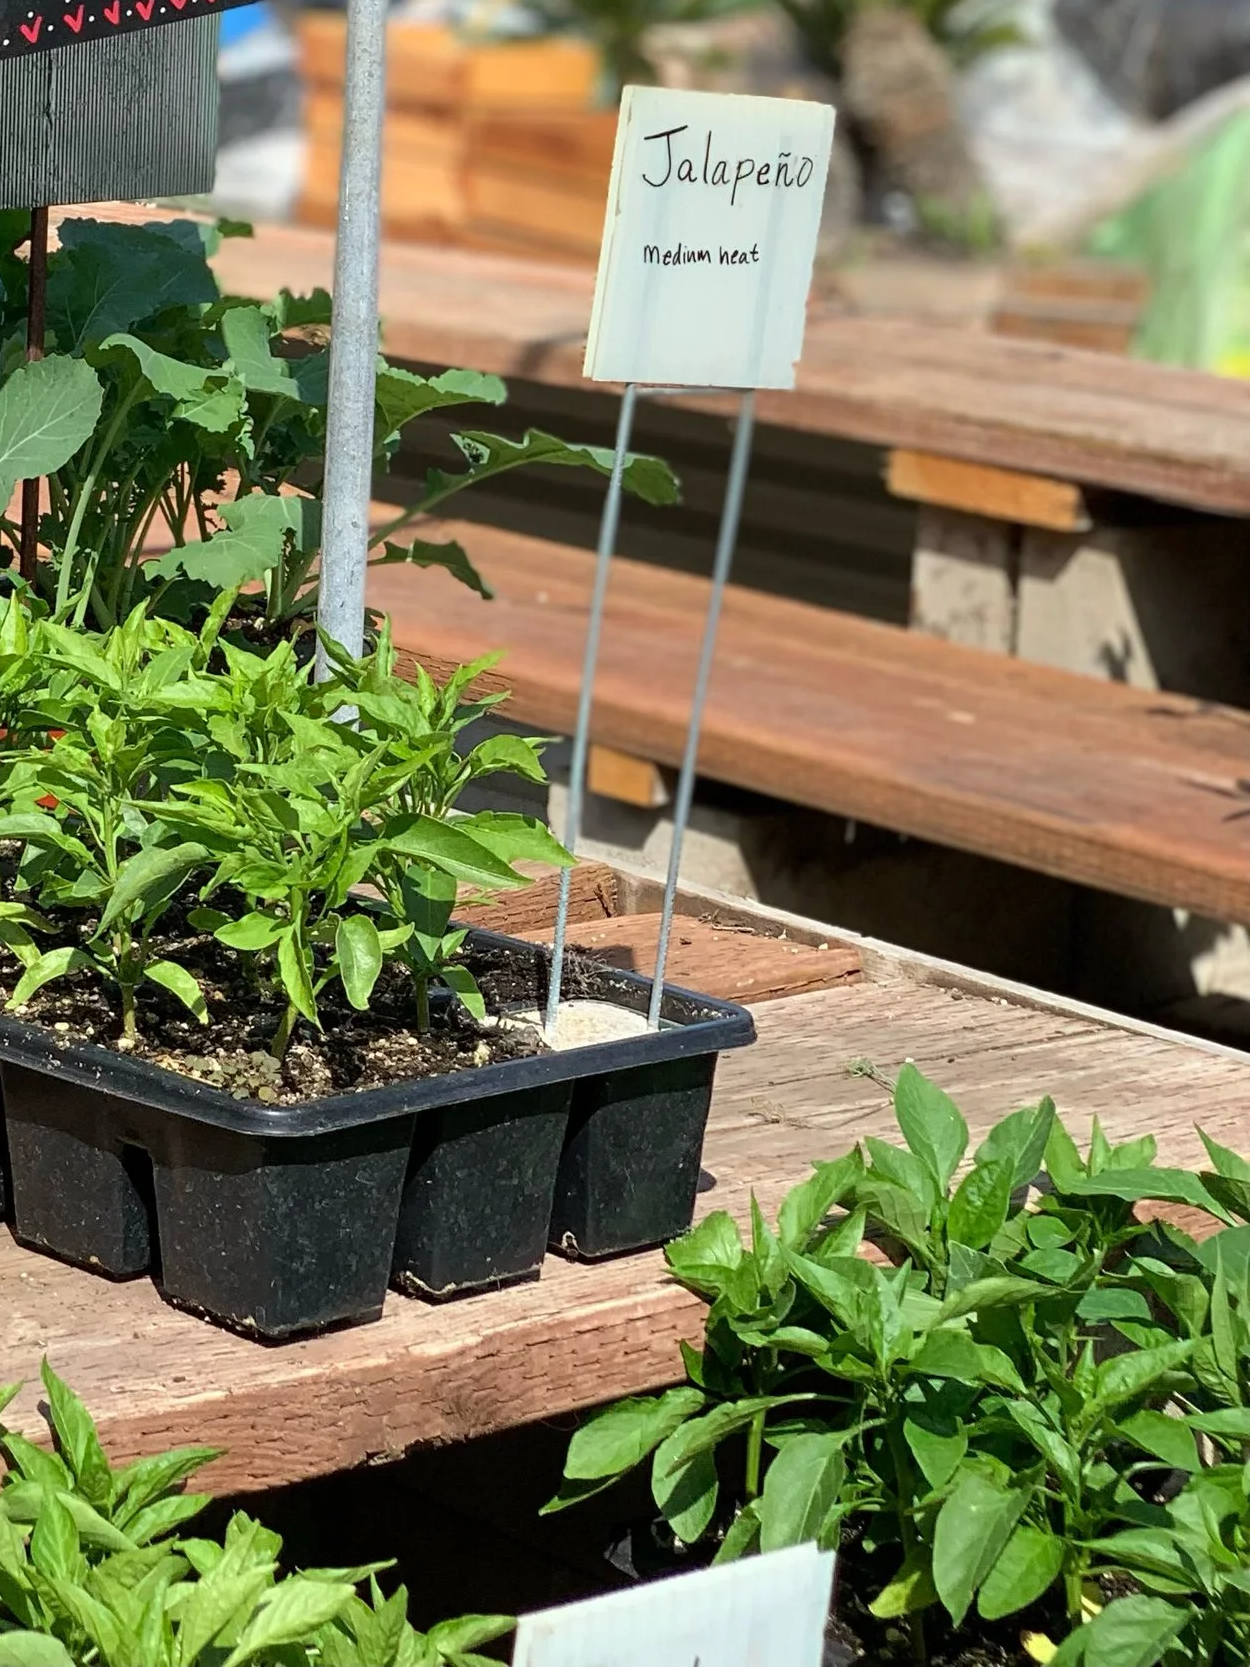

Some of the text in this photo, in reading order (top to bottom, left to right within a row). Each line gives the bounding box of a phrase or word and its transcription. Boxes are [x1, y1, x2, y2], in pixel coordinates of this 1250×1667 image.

[641, 123, 815, 207] Jalapeño
[642, 242, 760, 267] Medium heat
